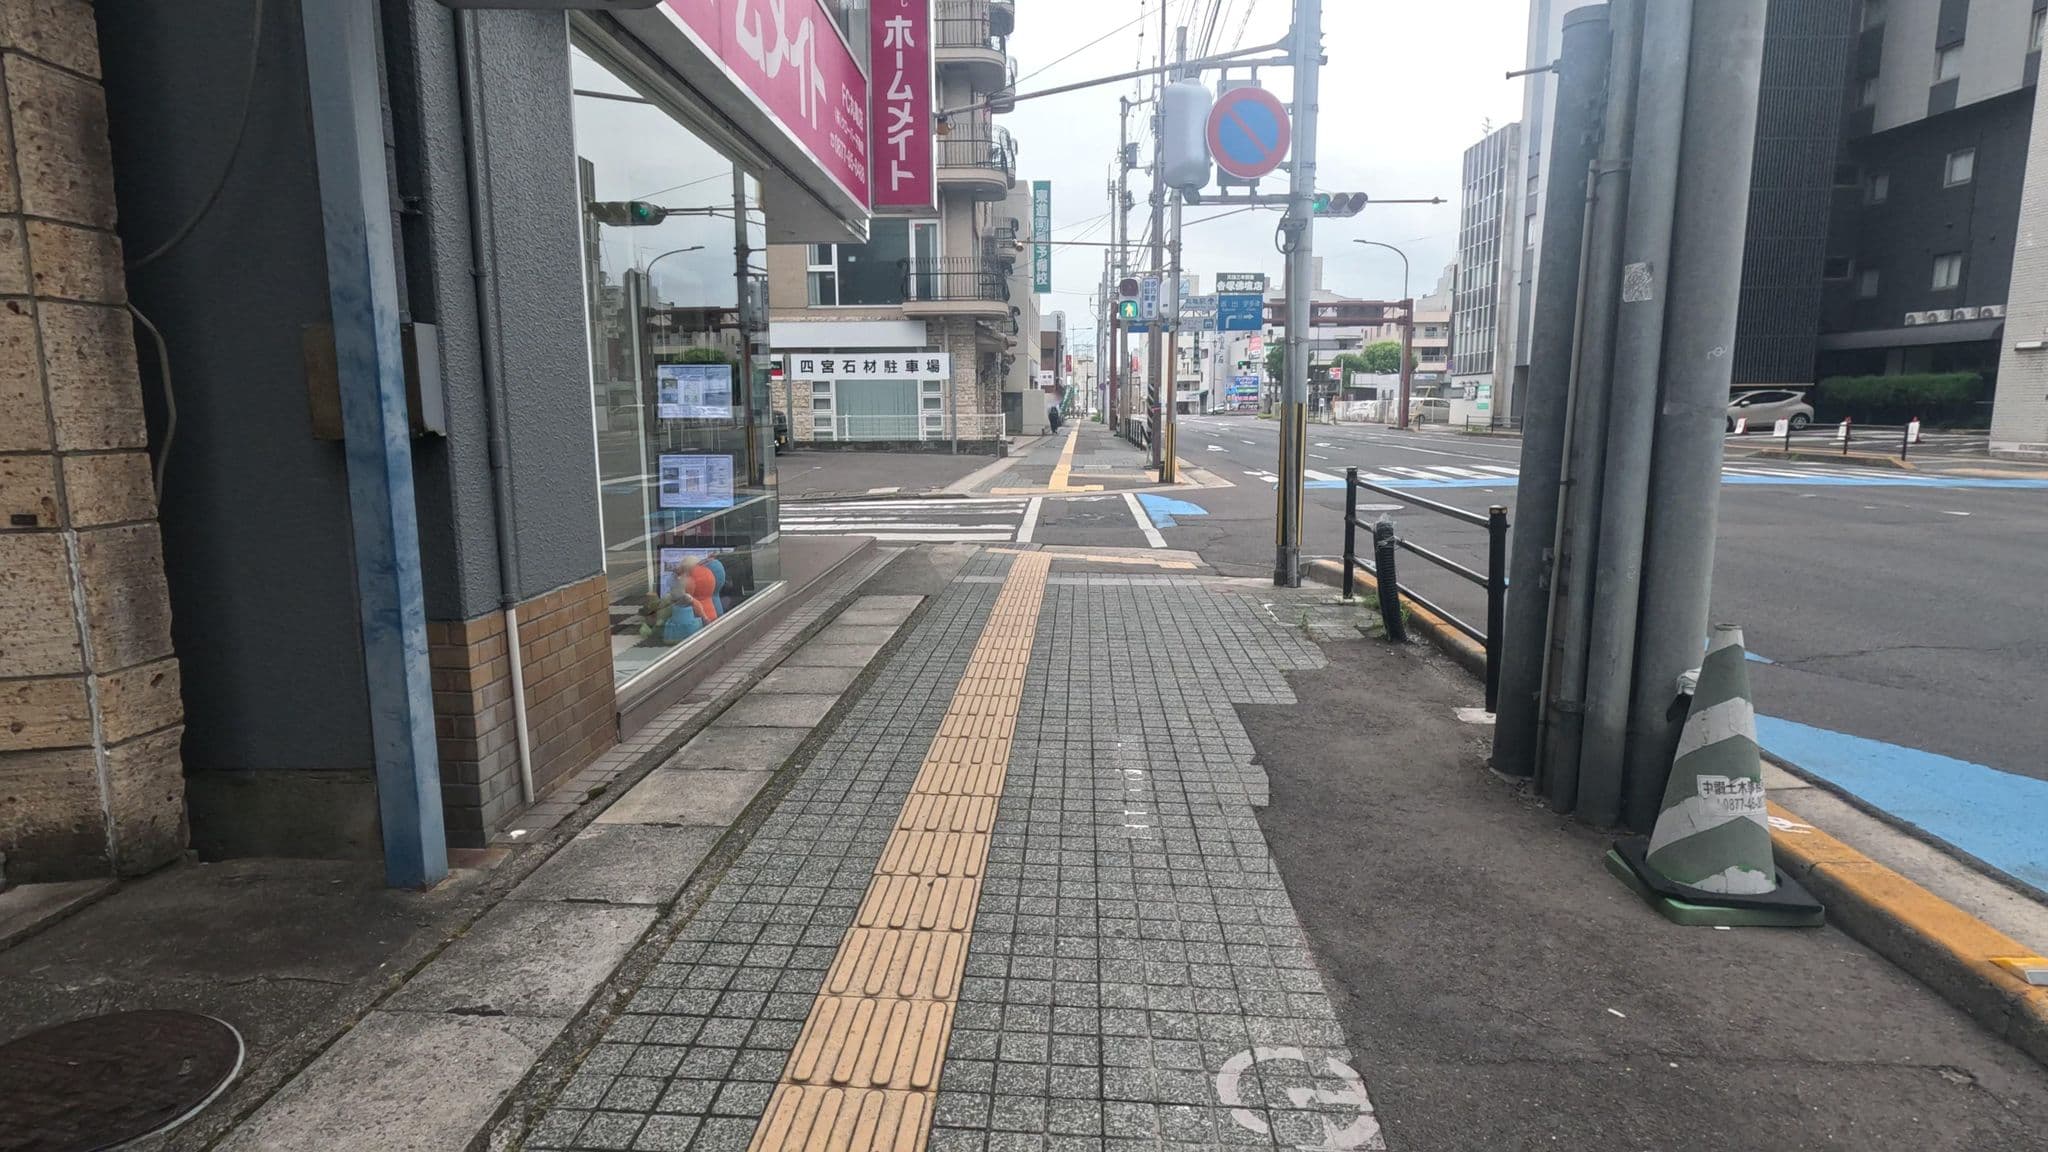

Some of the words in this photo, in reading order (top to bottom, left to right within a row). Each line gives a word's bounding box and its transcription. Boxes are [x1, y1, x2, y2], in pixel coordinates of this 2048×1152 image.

[884, 15, 915, 191] ホームメイト
[800, 359, 941, 373] 四宮石材駐車場
